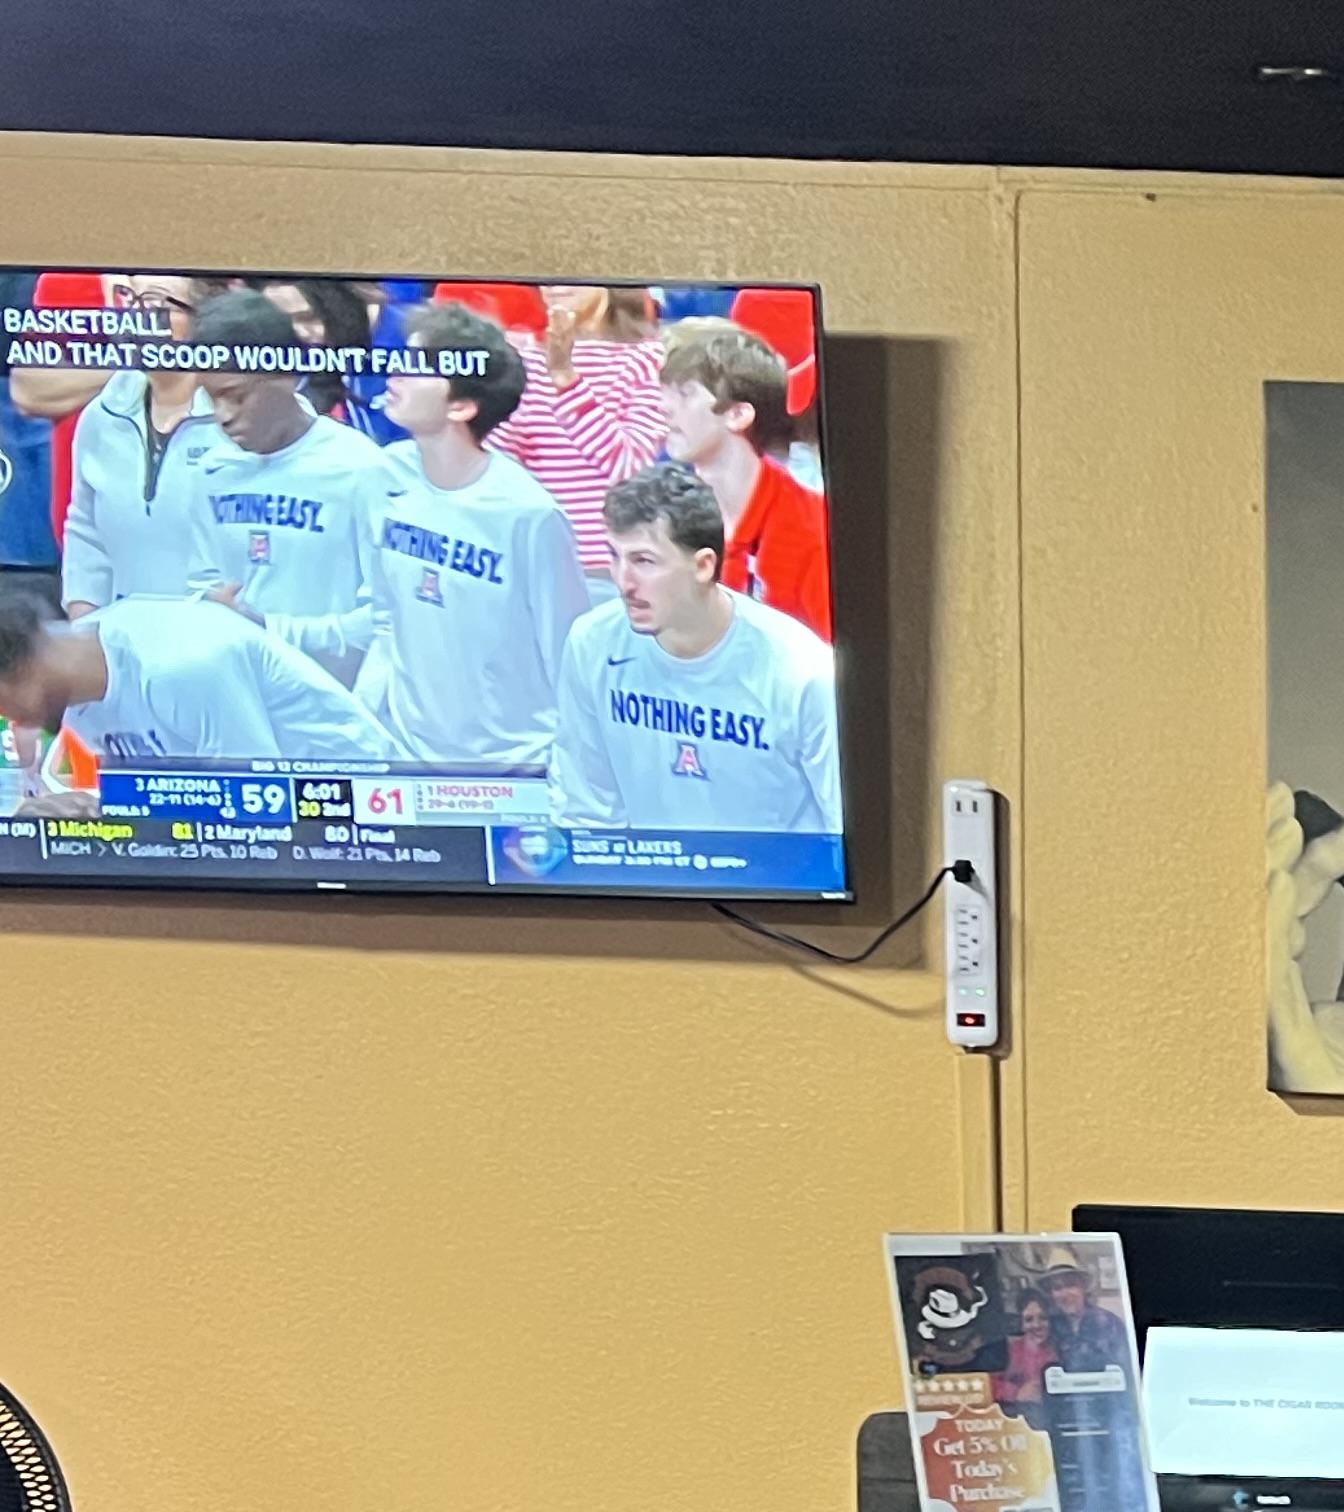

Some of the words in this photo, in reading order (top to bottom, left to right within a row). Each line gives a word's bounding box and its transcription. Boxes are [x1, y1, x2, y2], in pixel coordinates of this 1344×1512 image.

[7, 341, 62, 366] AND
[66, 342, 136, 368] THAT
[141, 344, 229, 370] SCOOP
[237, 346, 366, 373] WOULDN'T
[371, 349, 434, 375] FALL
[438, 350, 490, 377] BUT
[611, 689, 704, 739] NOTHING
[711, 709, 770, 750] EASY.
[252, 761, 275, 772] BIG
[277, 762, 291, 773] 12
[136, 778, 145, 791] 3
[146, 778, 222, 793] ARIZONA
[302, 783, 342, 800] 6:01
[436, 785, 513, 798] HOUSTON
[241, 783, 286, 816] 59
[368, 787, 403, 815] 61
[298, 801, 321, 818] 30
[322, 802, 351, 817] 2nd
[60, 821, 133, 841] Michigan
[172, 823, 193, 839] 81
[205, 824, 215, 840] 2
[217, 823, 292, 842] Maryland
[324, 827, 349, 842] 80
[360, 827, 395, 843] Final
[51, 841, 91, 855] MICH
[112, 842, 126, 856] V.
[180, 844, 199, 858] 25
[230, 845, 247, 858] 10
[250, 845, 278, 859] Reb
[395, 848, 410, 862] 14
[413, 848, 441, 862] Reb
[572, 840, 609, 854] SUNS
[627, 840, 682, 855] LAKERS
[1253, 1398, 1274, 1408] THE
[1278, 1399, 1312, 1409] CIGAR
[953, 1418, 1005, 1433] TODAY
[933, 1437, 966, 1457] Get
[969, 1436, 998, 1454] 5%
[951, 1458, 1018, 1482] Today's
[949, 1483, 1025, 1503] Purchase
